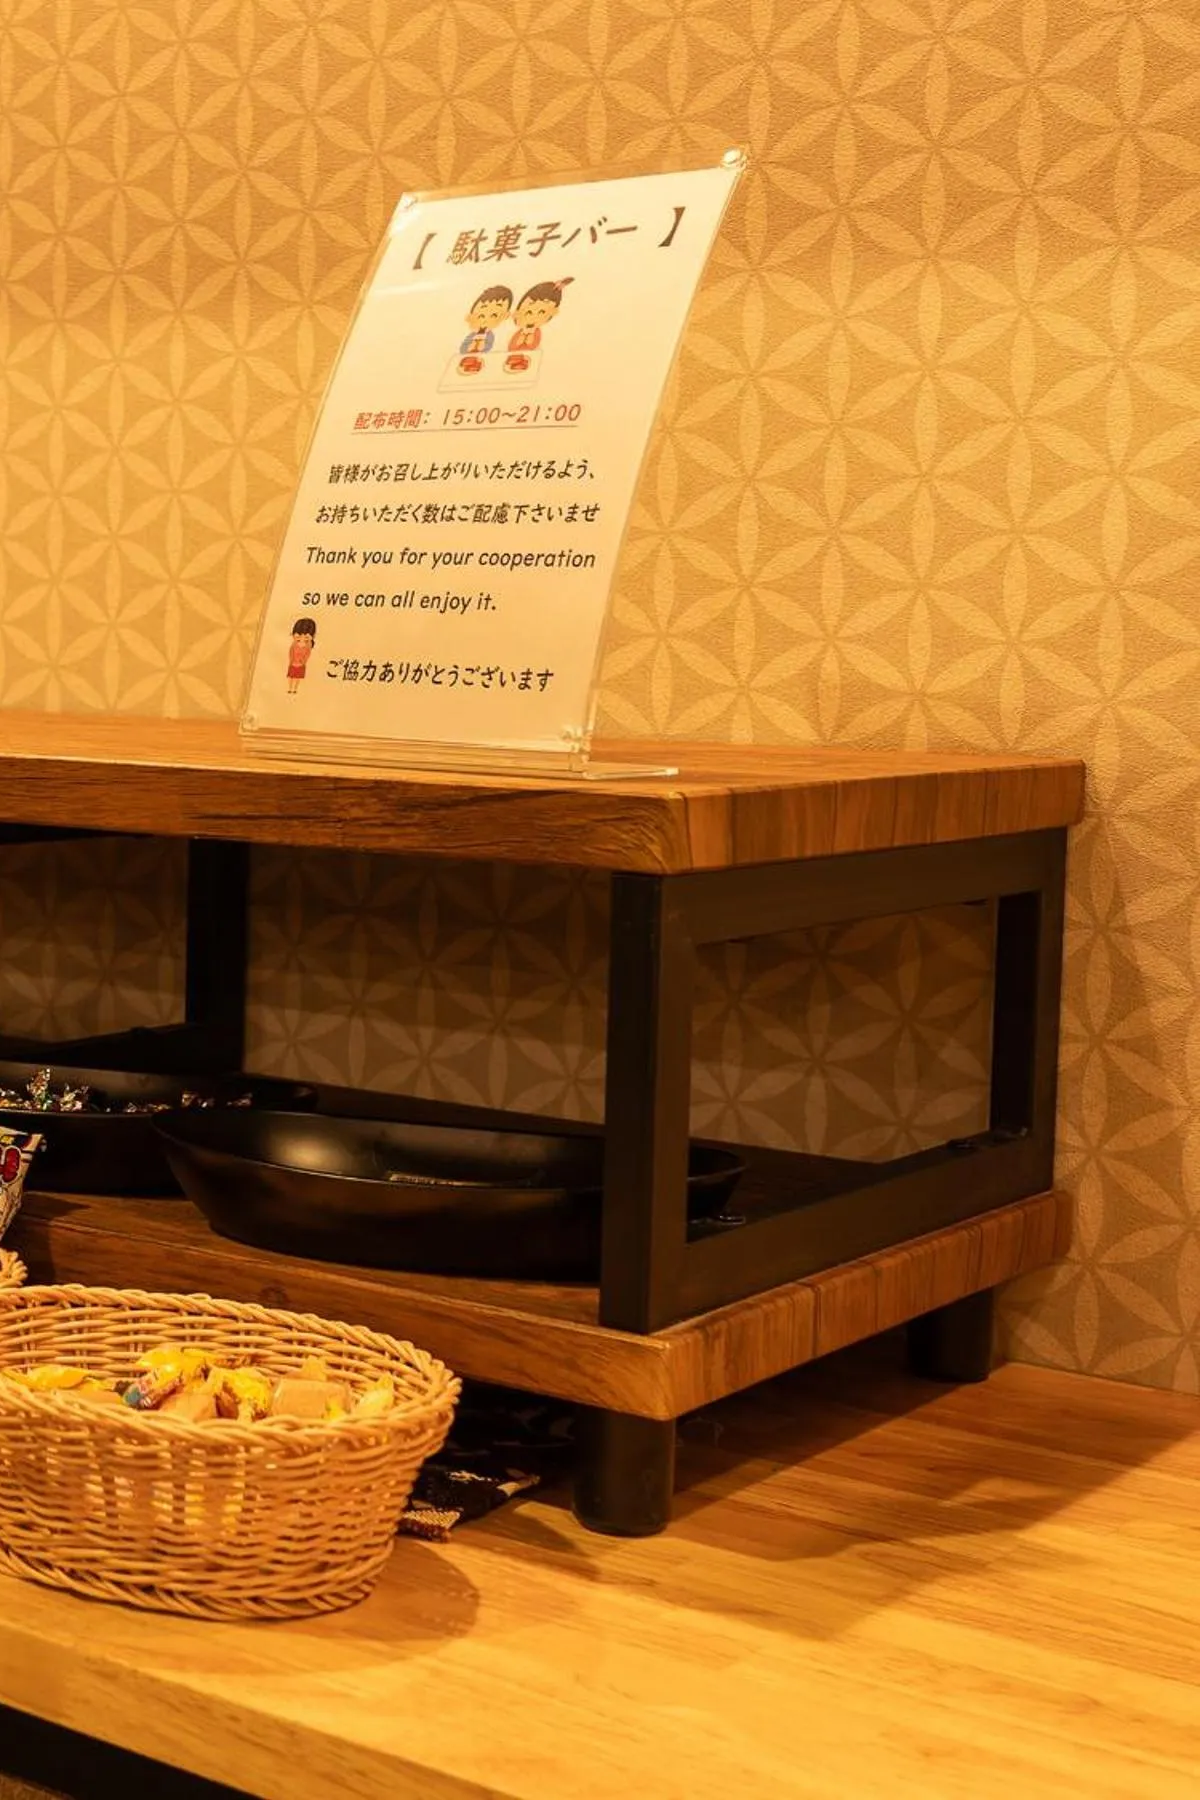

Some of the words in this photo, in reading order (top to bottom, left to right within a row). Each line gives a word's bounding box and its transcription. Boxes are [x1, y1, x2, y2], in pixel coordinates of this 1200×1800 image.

[328, 458, 595, 485] 皆様がお召し上がりいただけるよう、
[315, 501, 601, 526] お持ちいただく数はご配慮下さいませ
[305, 546, 358, 565] Thank
[361, 550, 394, 570] you
[399, 547, 428, 566] for
[431, 551, 475, 571] your
[477, 548, 596, 572] cooperation
[301, 591, 321, 606] so
[325, 592, 350, 607] we
[354, 593, 386, 608] can
[390, 590, 416, 609] all
[419, 591, 473, 616] enjoy
[476, 591, 498, 611] it.
[326, 658, 555, 693] ご協力ありがとうございます
